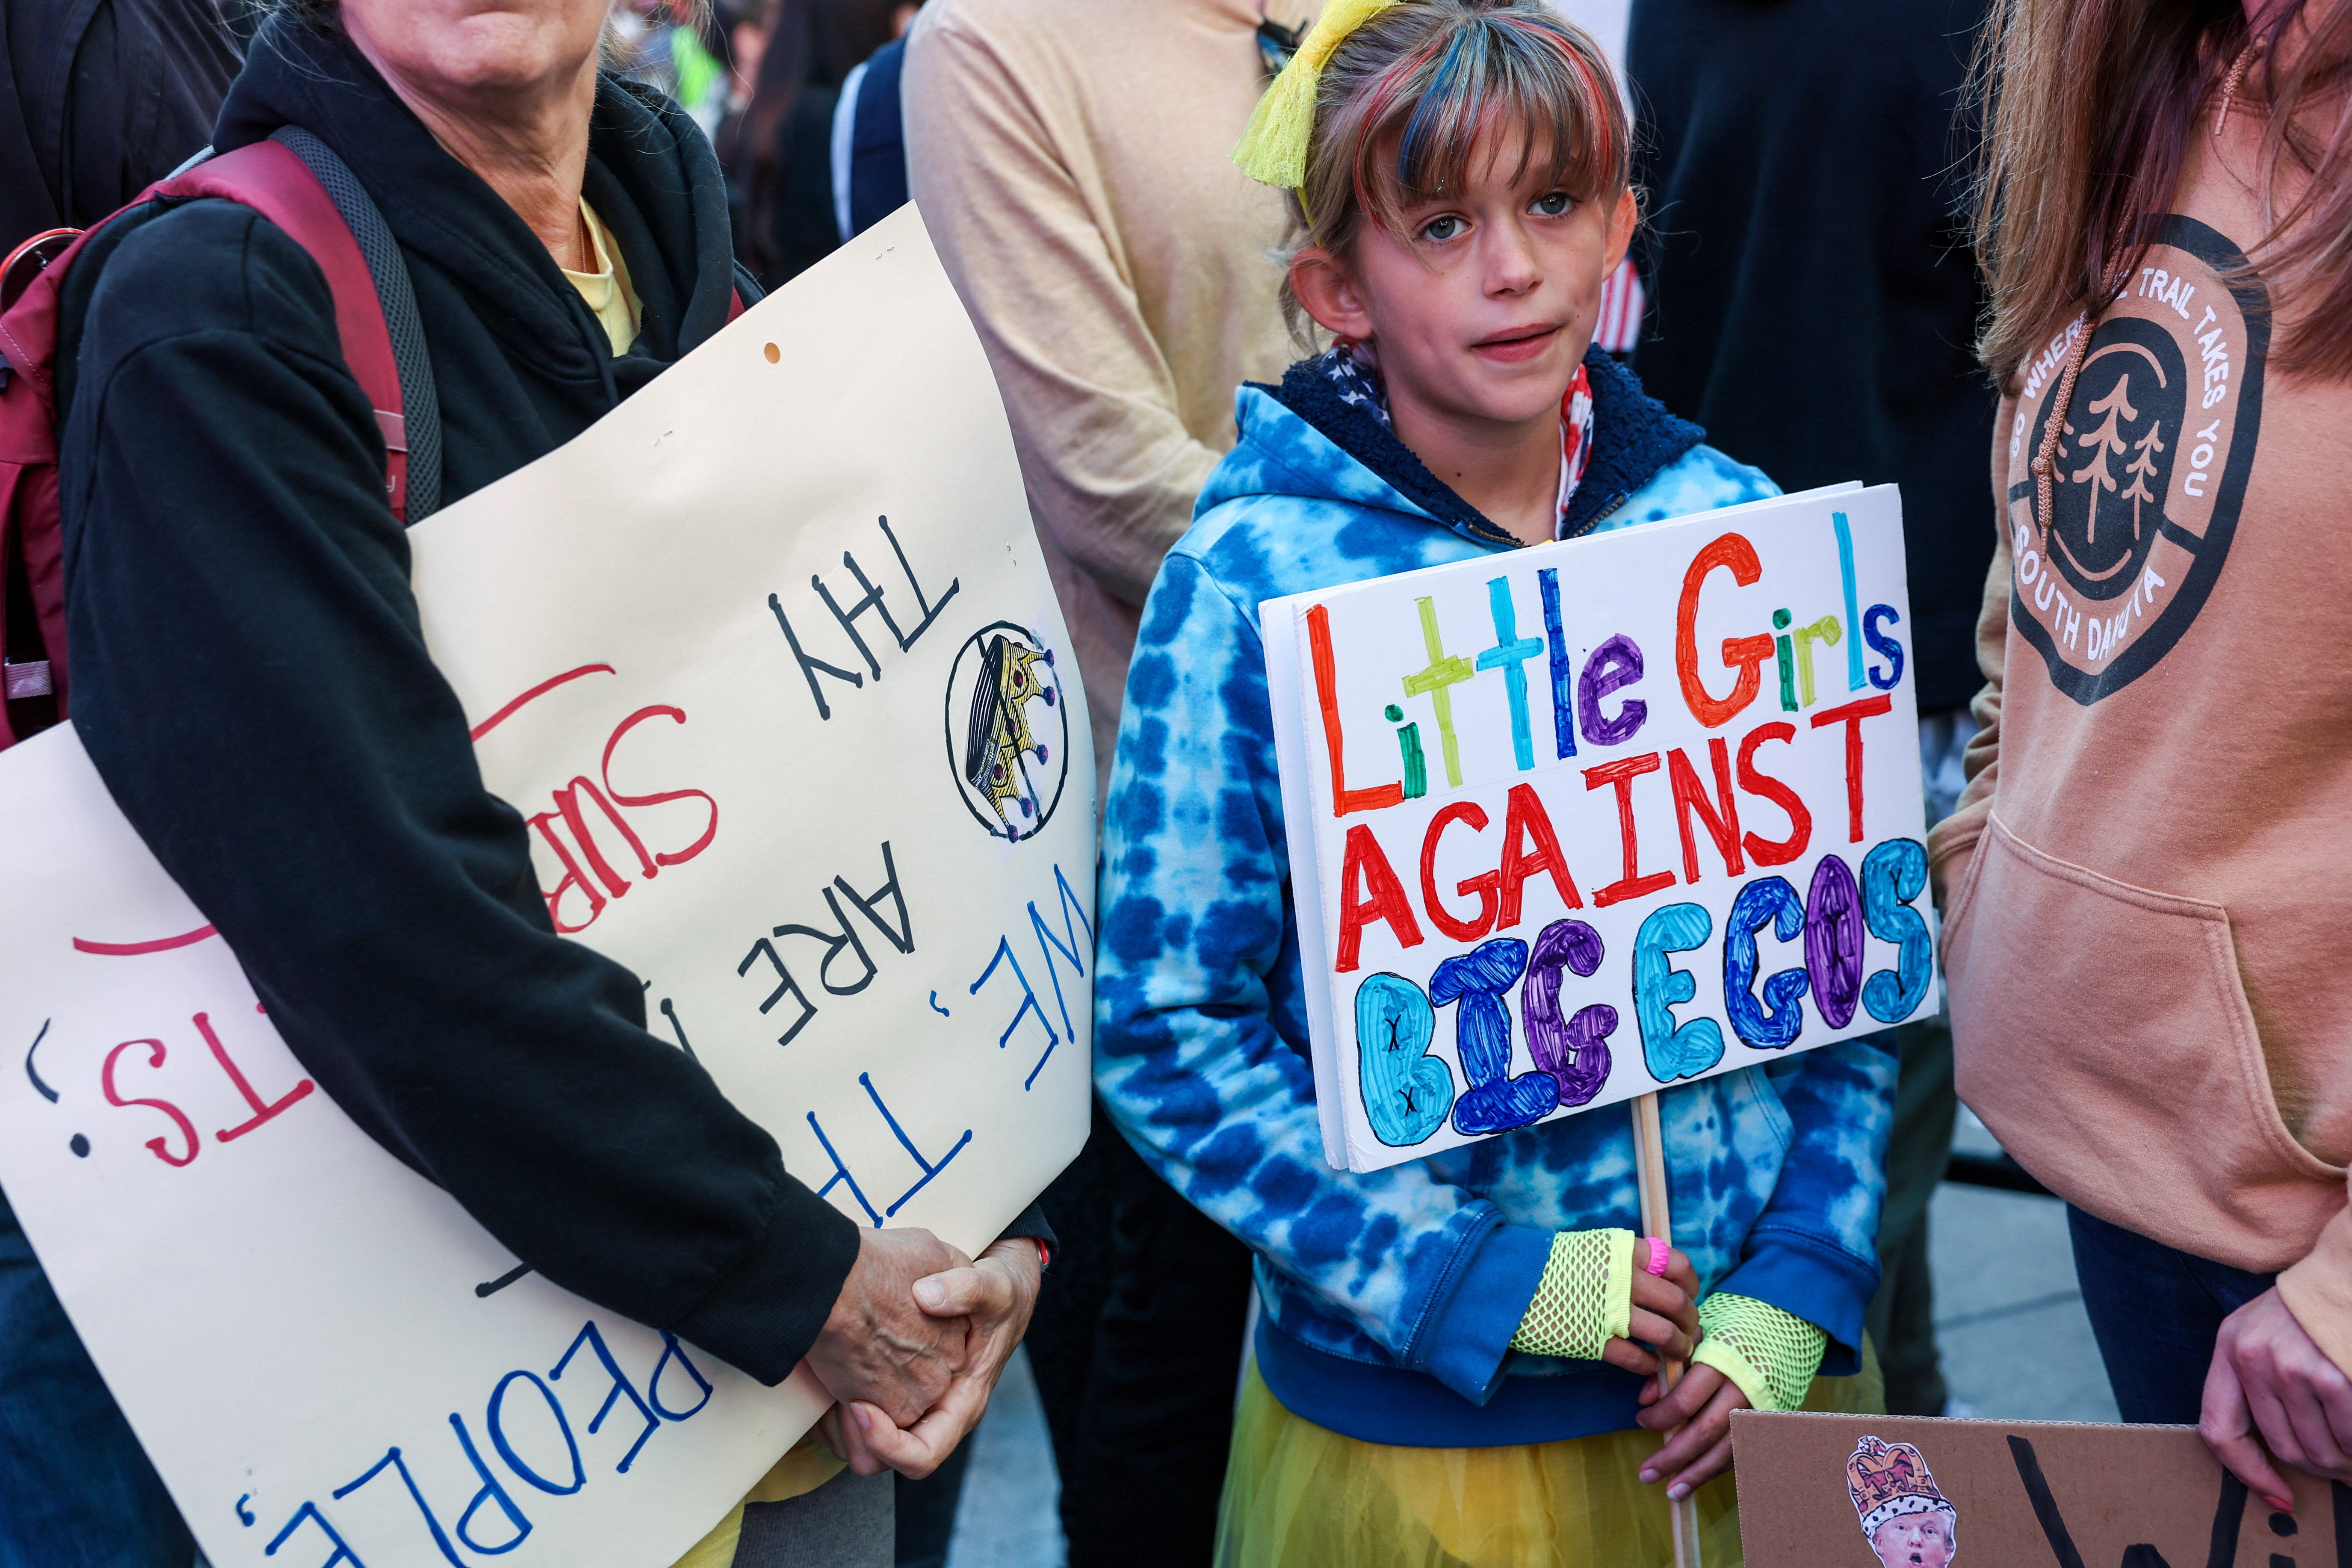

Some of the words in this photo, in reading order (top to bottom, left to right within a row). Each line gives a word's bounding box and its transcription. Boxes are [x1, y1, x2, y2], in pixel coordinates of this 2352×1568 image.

[2139, 267, 2195, 320] TRAIL
[2193, 305, 2229, 410] TAKES
[2012, 412, 2026, 458] GO
[2184, 419, 2221, 497] YOU
[768, 514, 960, 721] THY
[1306, 567, 1648, 818] Little
[1675, 512, 1904, 729] Girls
[2016, 524, 2080, 651] SOUTH
[1334, 693, 1892, 973] AGAINST
[736, 840, 916, 1046] ARE
[1354, 917, 1619, 1147] BIG
[1632, 837, 1933, 1083] EGOS
